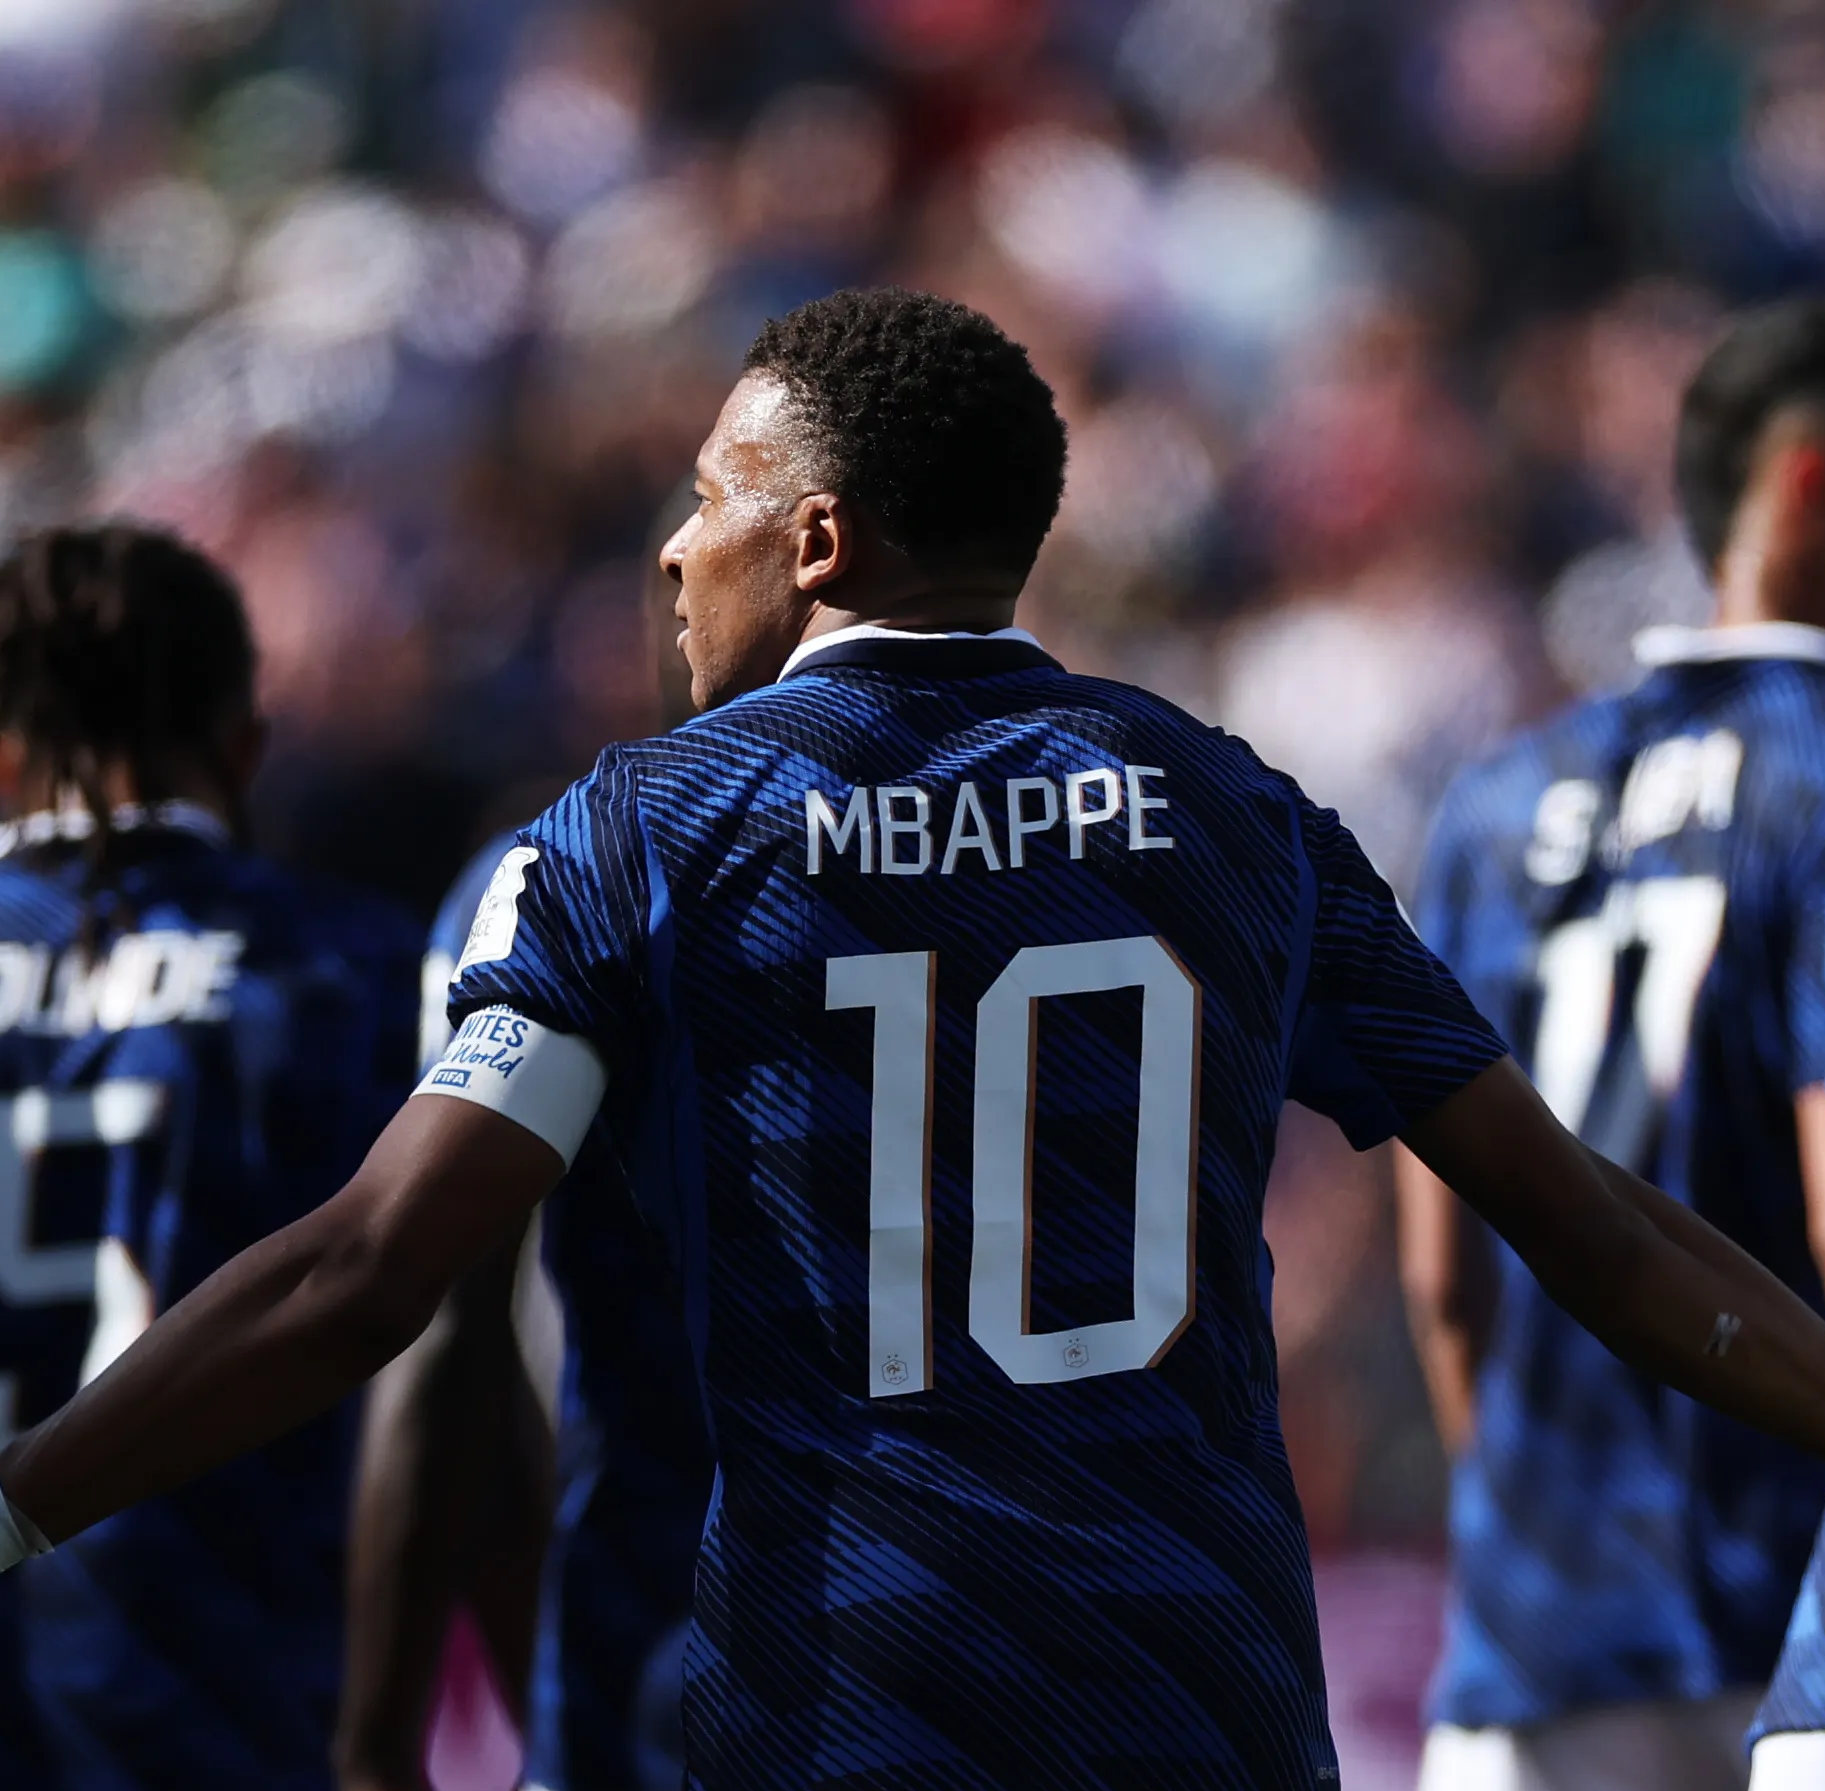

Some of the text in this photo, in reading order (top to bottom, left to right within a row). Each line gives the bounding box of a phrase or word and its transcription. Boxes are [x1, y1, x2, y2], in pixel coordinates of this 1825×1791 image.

[803, 765, 1176, 875] MBAPPE
[435, 1071, 465, 1085] FIFA
[453, 1042, 524, 1079] World
[825, 935, 1201, 1398] 10
